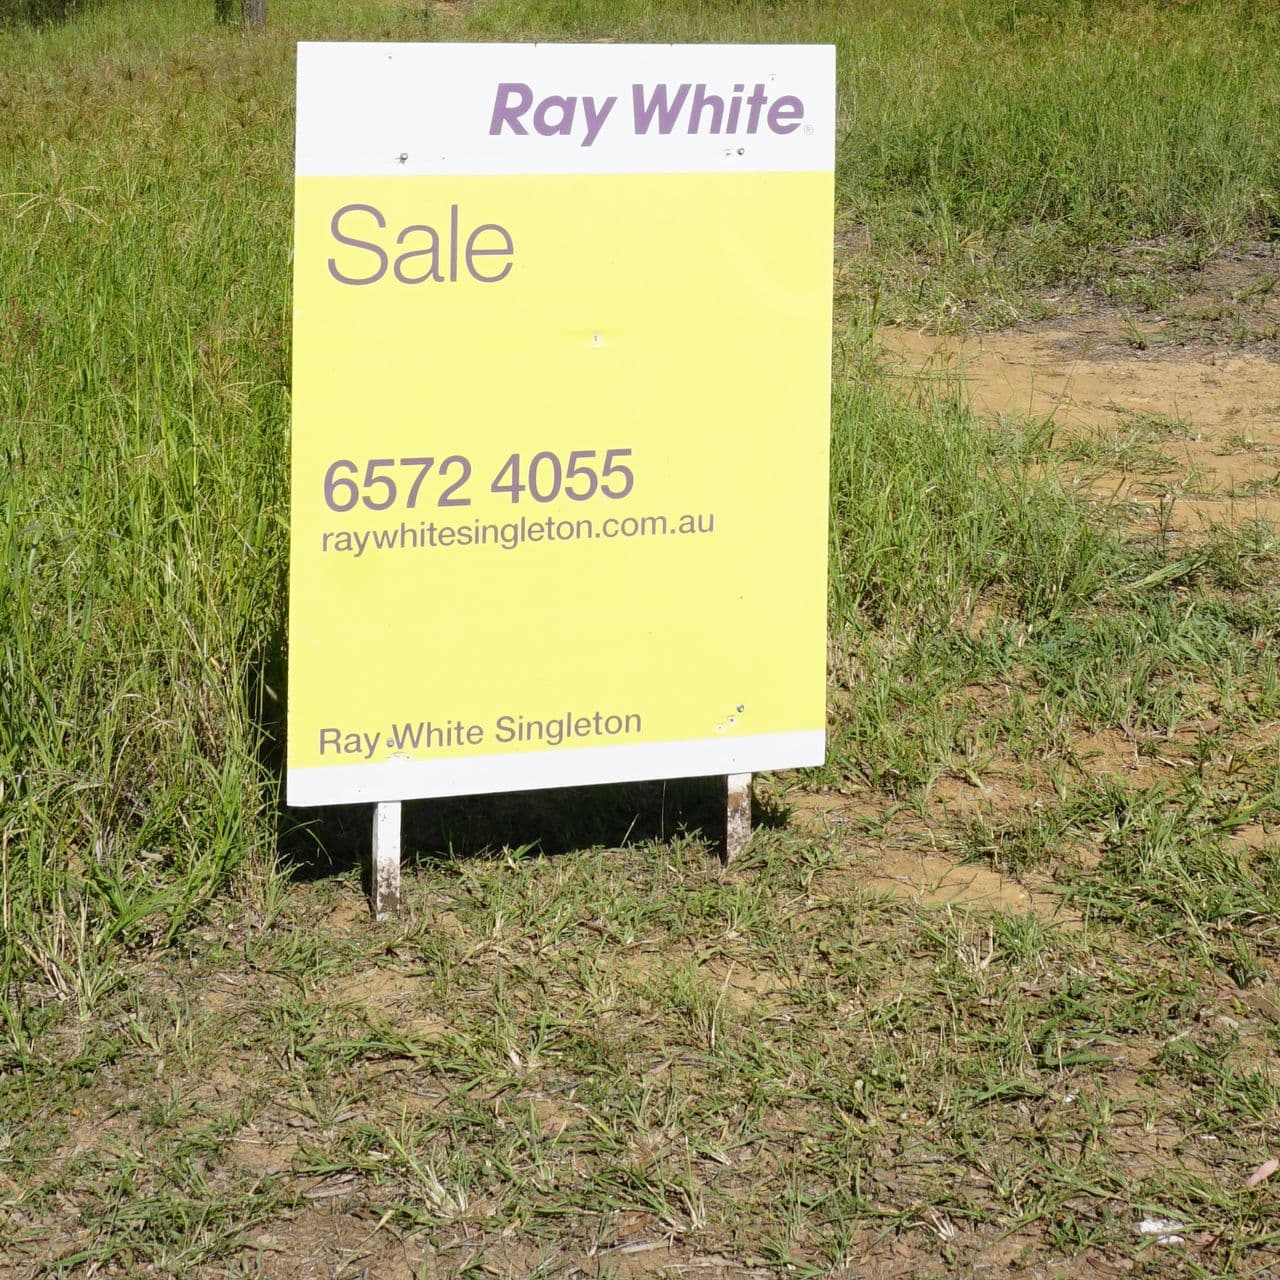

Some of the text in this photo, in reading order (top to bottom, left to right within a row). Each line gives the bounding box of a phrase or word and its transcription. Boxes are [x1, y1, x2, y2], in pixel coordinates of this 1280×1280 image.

[489, 83, 804, 146] Ray White
[328, 204, 513, 285] Sale
[323, 449, 633, 512] 6572 4055
[322, 513, 714, 557] raywhitesingleton.com.au
[320, 712, 641, 759] Ray White Singleton
